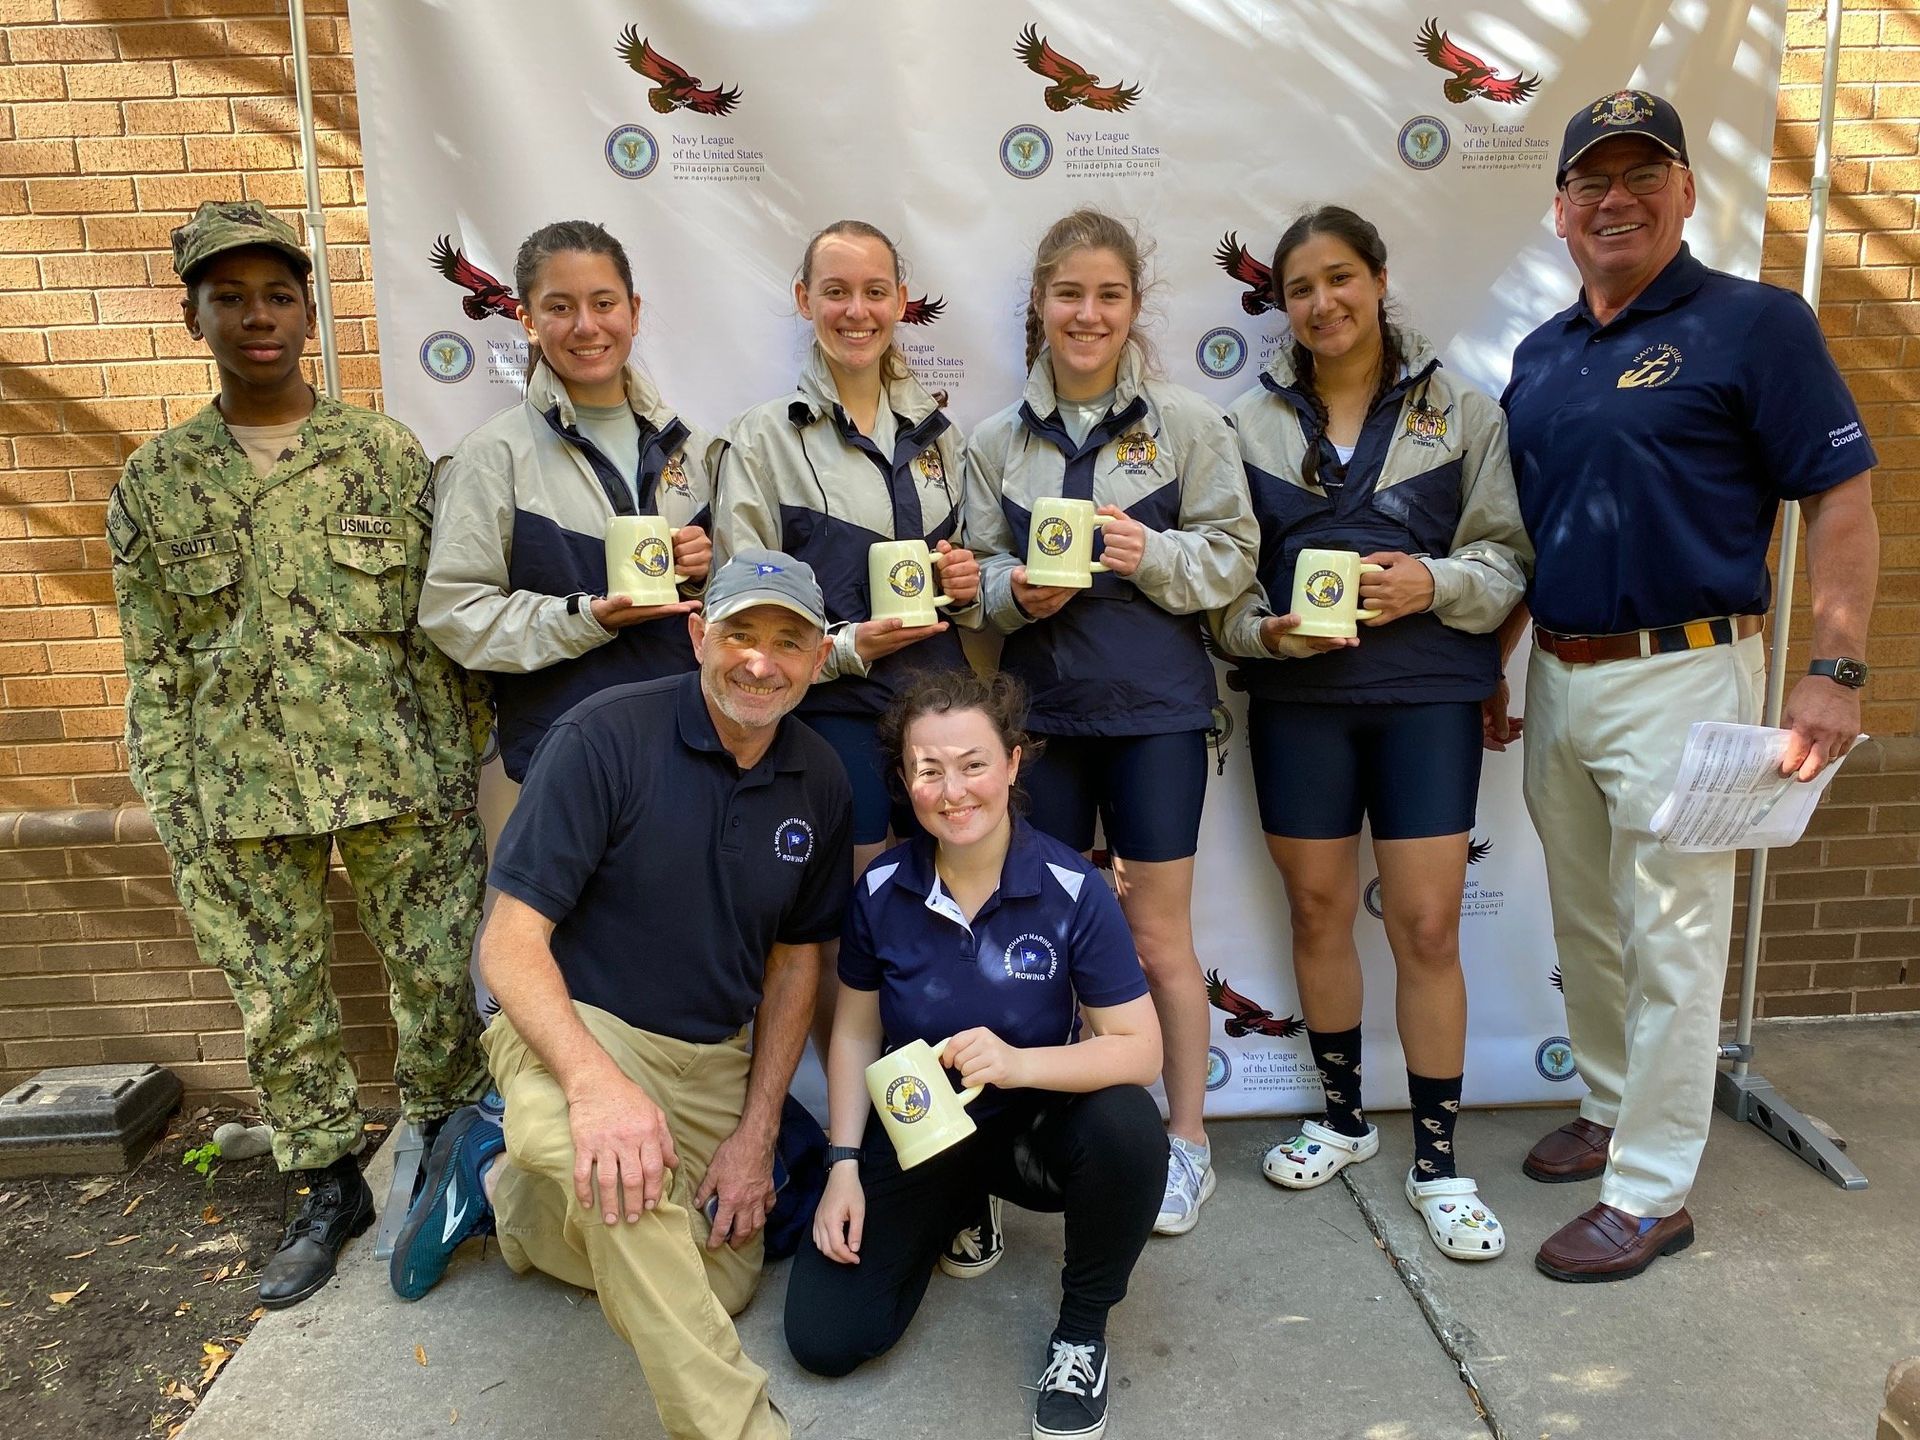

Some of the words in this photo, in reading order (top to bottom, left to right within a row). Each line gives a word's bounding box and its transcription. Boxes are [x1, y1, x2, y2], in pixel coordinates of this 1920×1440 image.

[1464, 124, 1489, 135] Navy
[1492, 123, 1525, 134] League
[672, 135, 697, 147] Navy
[701, 135, 734, 147] League
[1066, 132, 1092, 143] Navy
[1095, 131, 1130, 142] League
[1463, 139, 1474, 148] of
[1475, 139, 1489, 148] the
[1492, 138, 1523, 148] United
[1525, 138, 1549, 148] States
[673, 150, 684, 159] of
[685, 150, 700, 159] the
[703, 150, 734, 160] United
[737, 150, 763, 159] States
[1066, 148, 1078, 157] of
[1079, 147, 1094, 156] the
[1097, 146, 1129, 156] United
[1131, 145, 1160, 155] States
[1462, 154, 1515, 163] Philadelphia
[1518, 153, 1548, 161] Council
[673, 165, 729, 174] Philadelphia
[733, 165, 765, 173] Council
[1066, 161, 1123, 170] Philadelphia
[1126, 160, 1160, 168] Council
[487, 340, 511, 351] Navy
[513, 340, 529, 350] Lea
[1261, 335, 1285, 346] Navy
[902, 343, 935, 354] League
[1260, 349, 1271, 358] of
[488, 354, 498, 363] of
[500, 354, 513, 363] the
[1633, 346, 1655, 363] NAVY
[1657, 344, 1682, 364] LEAGUE
[904, 356, 934, 366] United
[937, 356, 964, 366] States
[932, 371, 965, 379] Council
[339, 518, 392, 535] USNLCC
[171, 536, 217, 558] SCUTT
[1479, 889, 1504, 898] States
[1474, 901, 1504, 909] Council
[1014, 971, 1046, 981] ROWING
[1242, 1052, 1265, 1062] Navy
[1268, 1051, 1298, 1061] League
[1243, 1064, 1254, 1073] of
[1254, 1064, 1267, 1073] the
[1270, 1064, 1297, 1073] United
[1299, 1063, 1318, 1072] Stat
